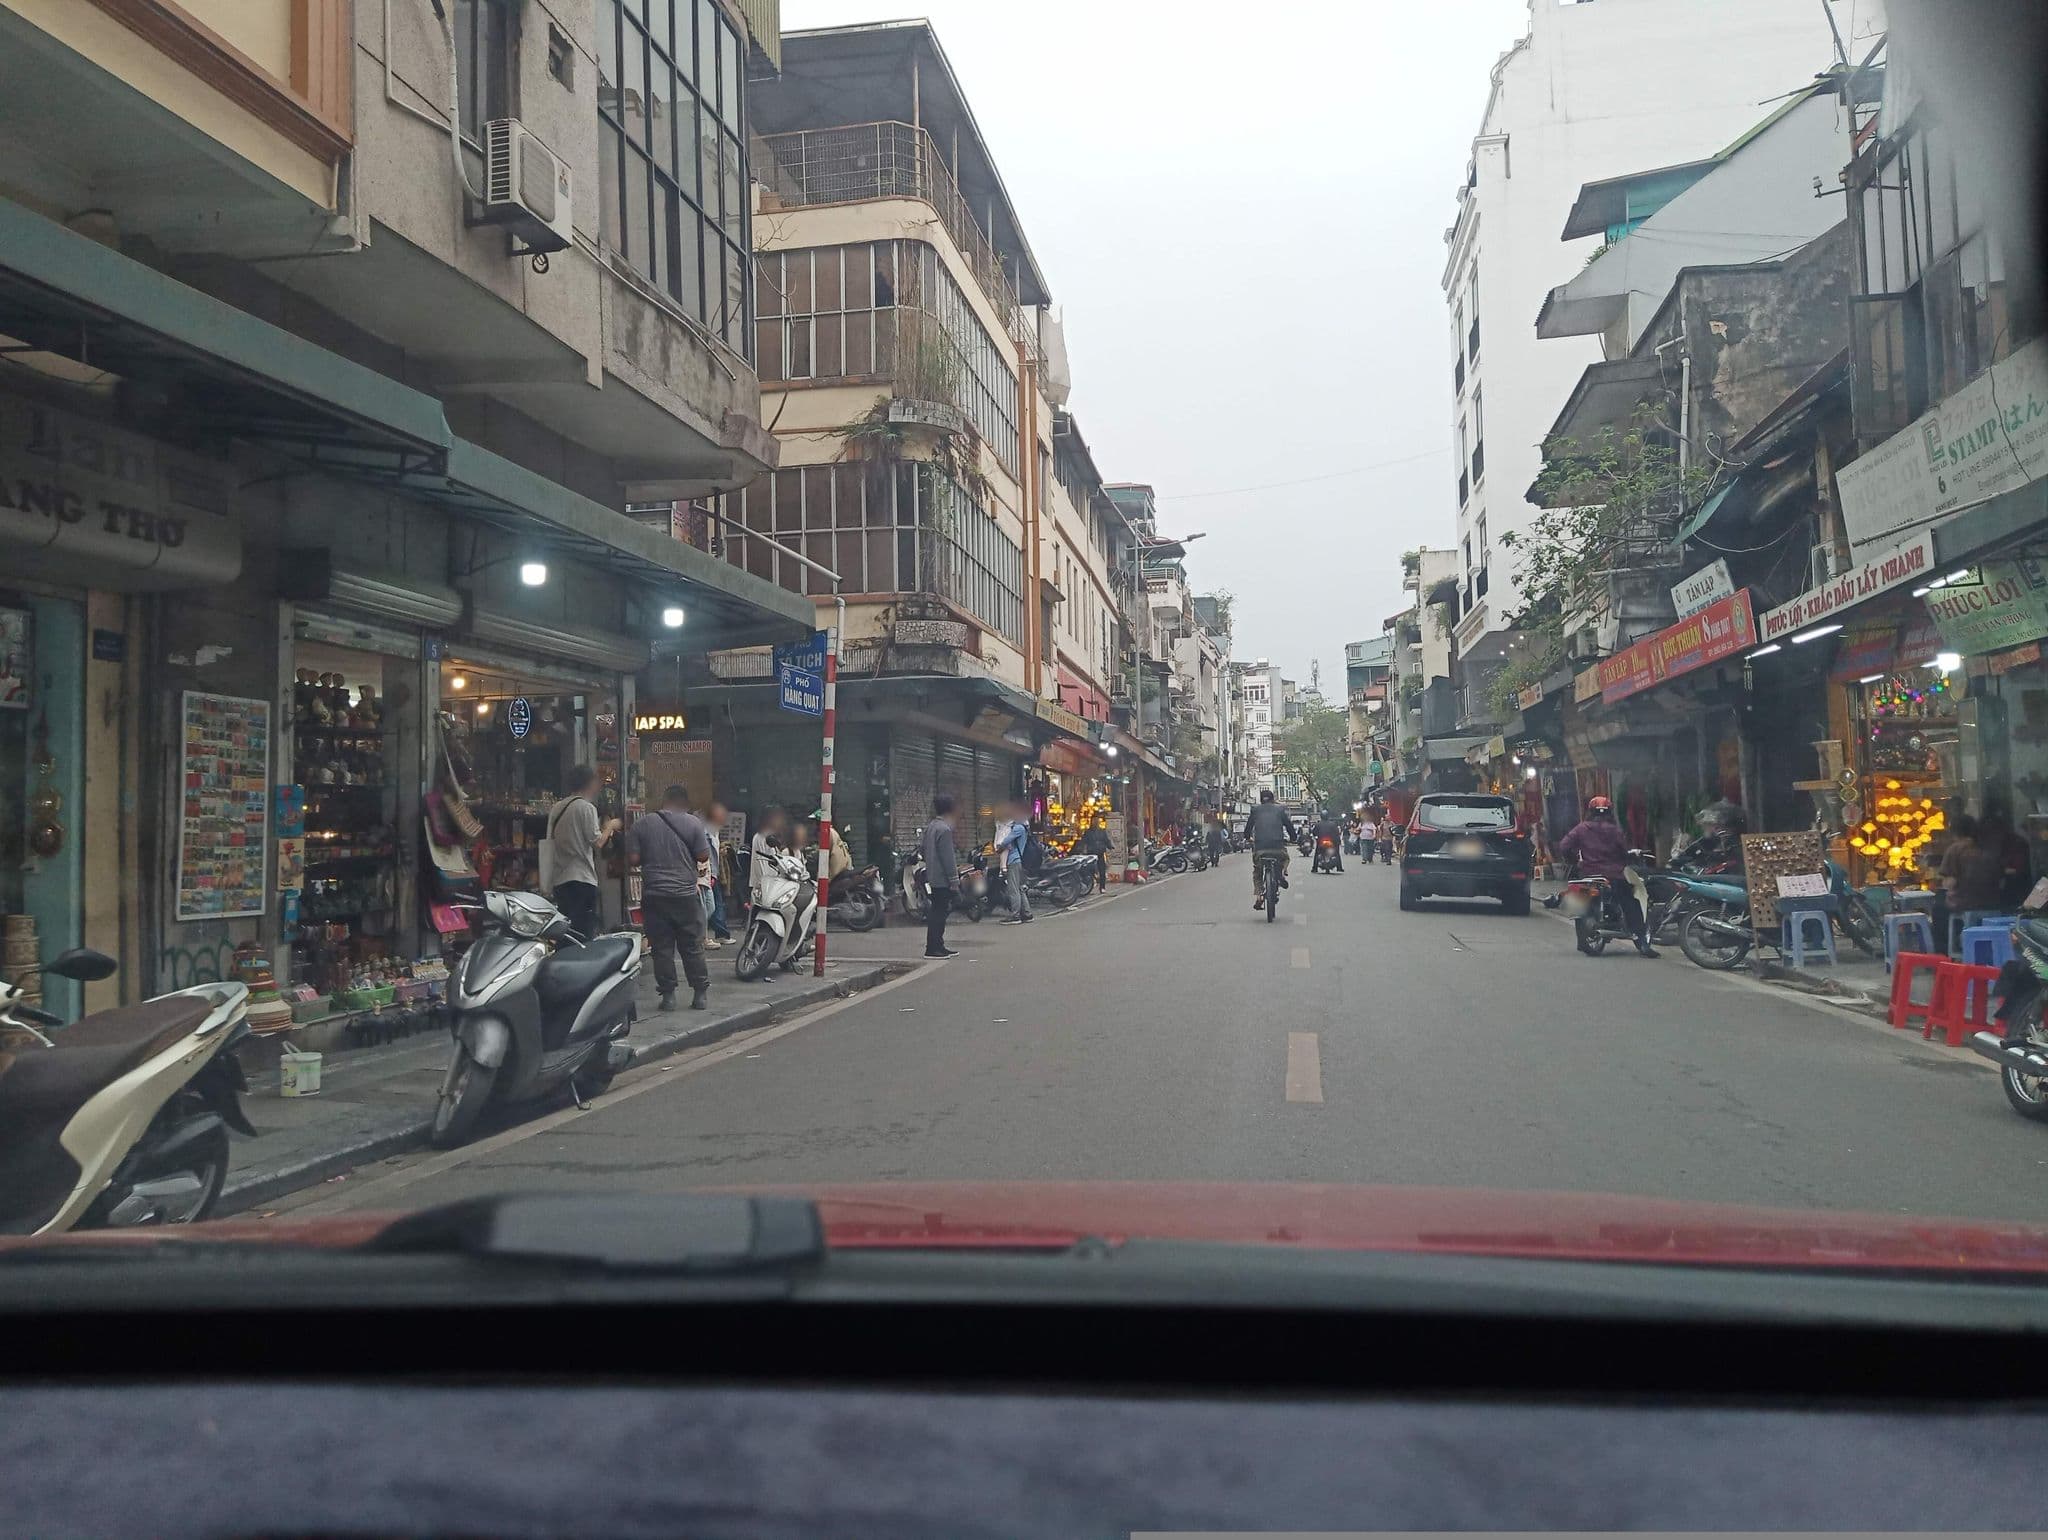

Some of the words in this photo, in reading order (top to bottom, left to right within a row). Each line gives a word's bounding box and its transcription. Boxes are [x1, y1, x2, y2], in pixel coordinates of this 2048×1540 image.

[1951, 418, 1997, 465] STAMP
[1937, 475, 1947, 495] 6
[1766, 609, 1787, 636] PHÚC
[1834, 574, 1855, 608] DẤU
[1857, 563, 1879, 596] LẤY
[1880, 545, 1925, 586] NHANH
[1930, 588, 1983, 624] PHÚC
[1702, 614, 1712, 644] 8
[795, 676, 810, 688] PHỐ
[784, 685, 803, 706] HÀNG
[803, 692, 820, 713] QUẠT
[658, 715, 685, 730] SPA
